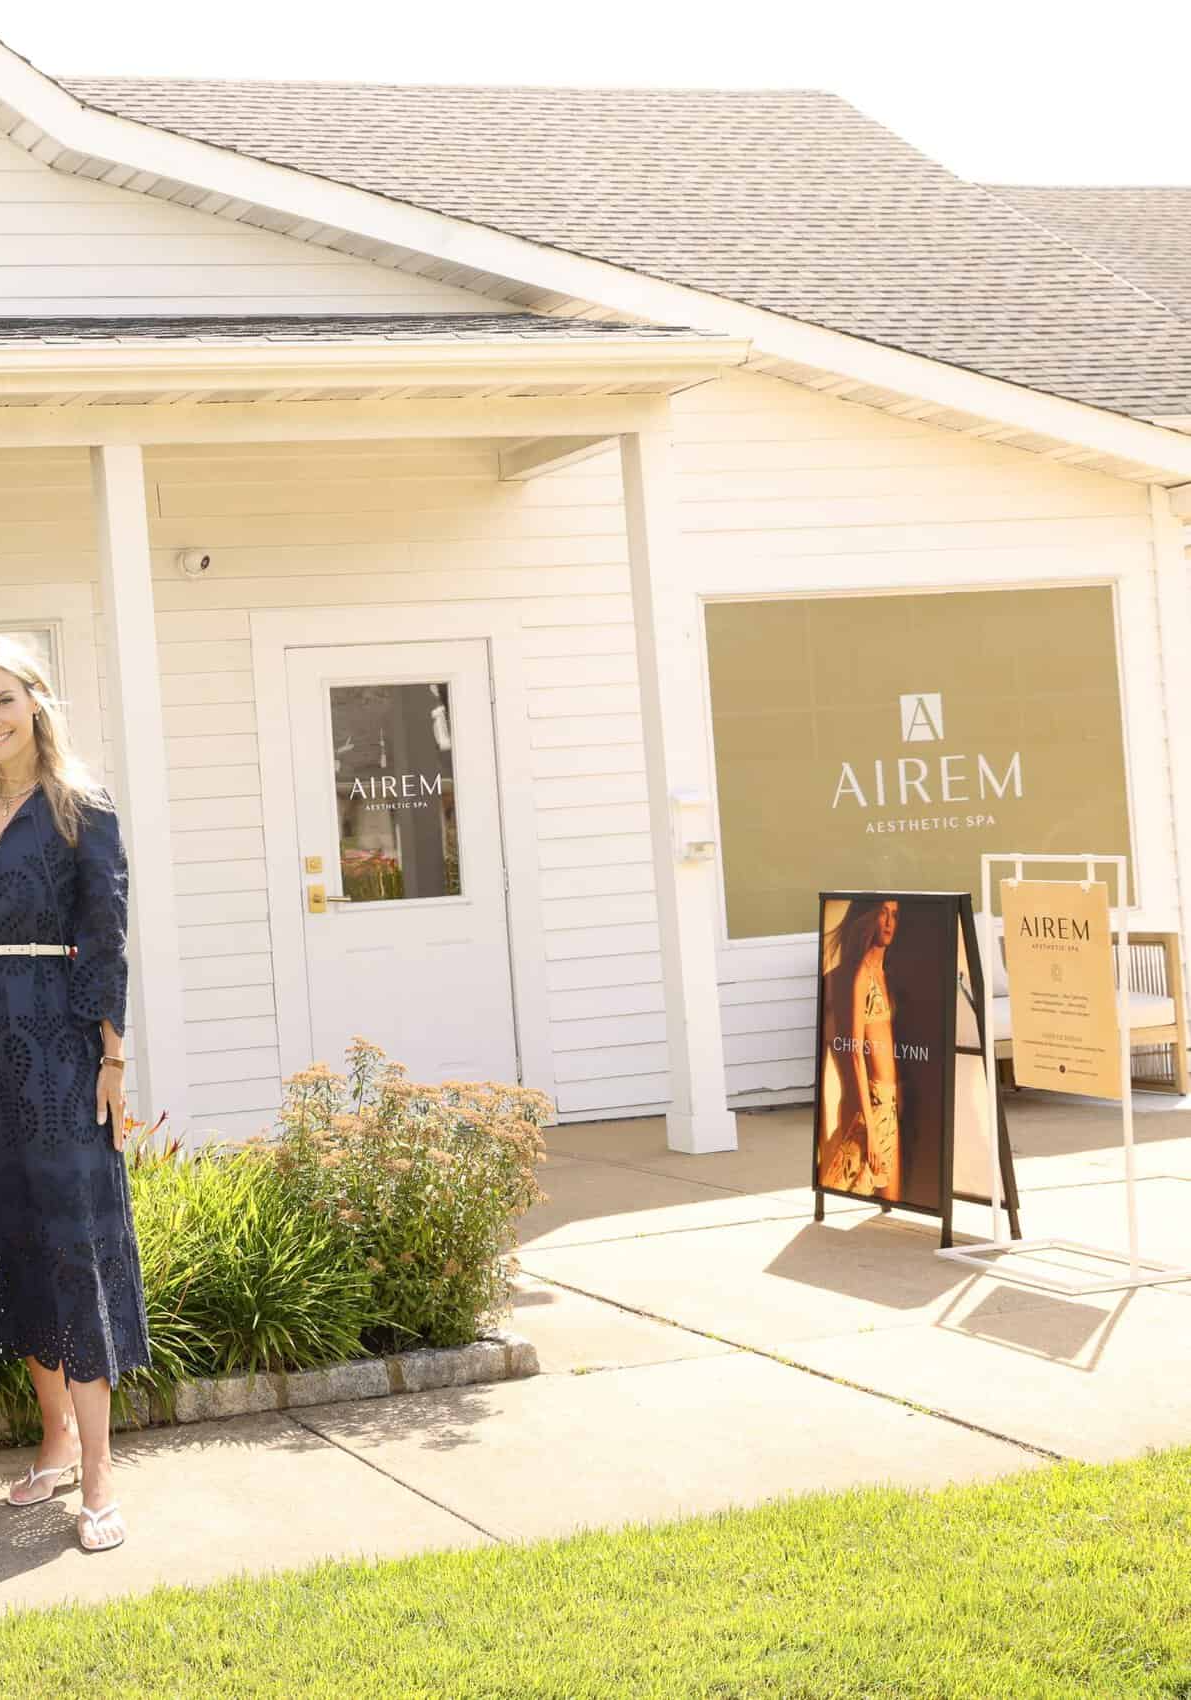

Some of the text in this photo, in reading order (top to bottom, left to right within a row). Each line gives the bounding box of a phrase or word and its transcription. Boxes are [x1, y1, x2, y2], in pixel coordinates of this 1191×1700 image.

[349, 773, 443, 801] AIREM
[831, 751, 1024, 809] AIREM
[365, 801, 428, 811] AESTHETIC SPA
[866, 814, 996, 833] AESTHETIC SPA
[1020, 916, 1090, 941] AIREM
[894, 1043, 929, 1062] LYNN
